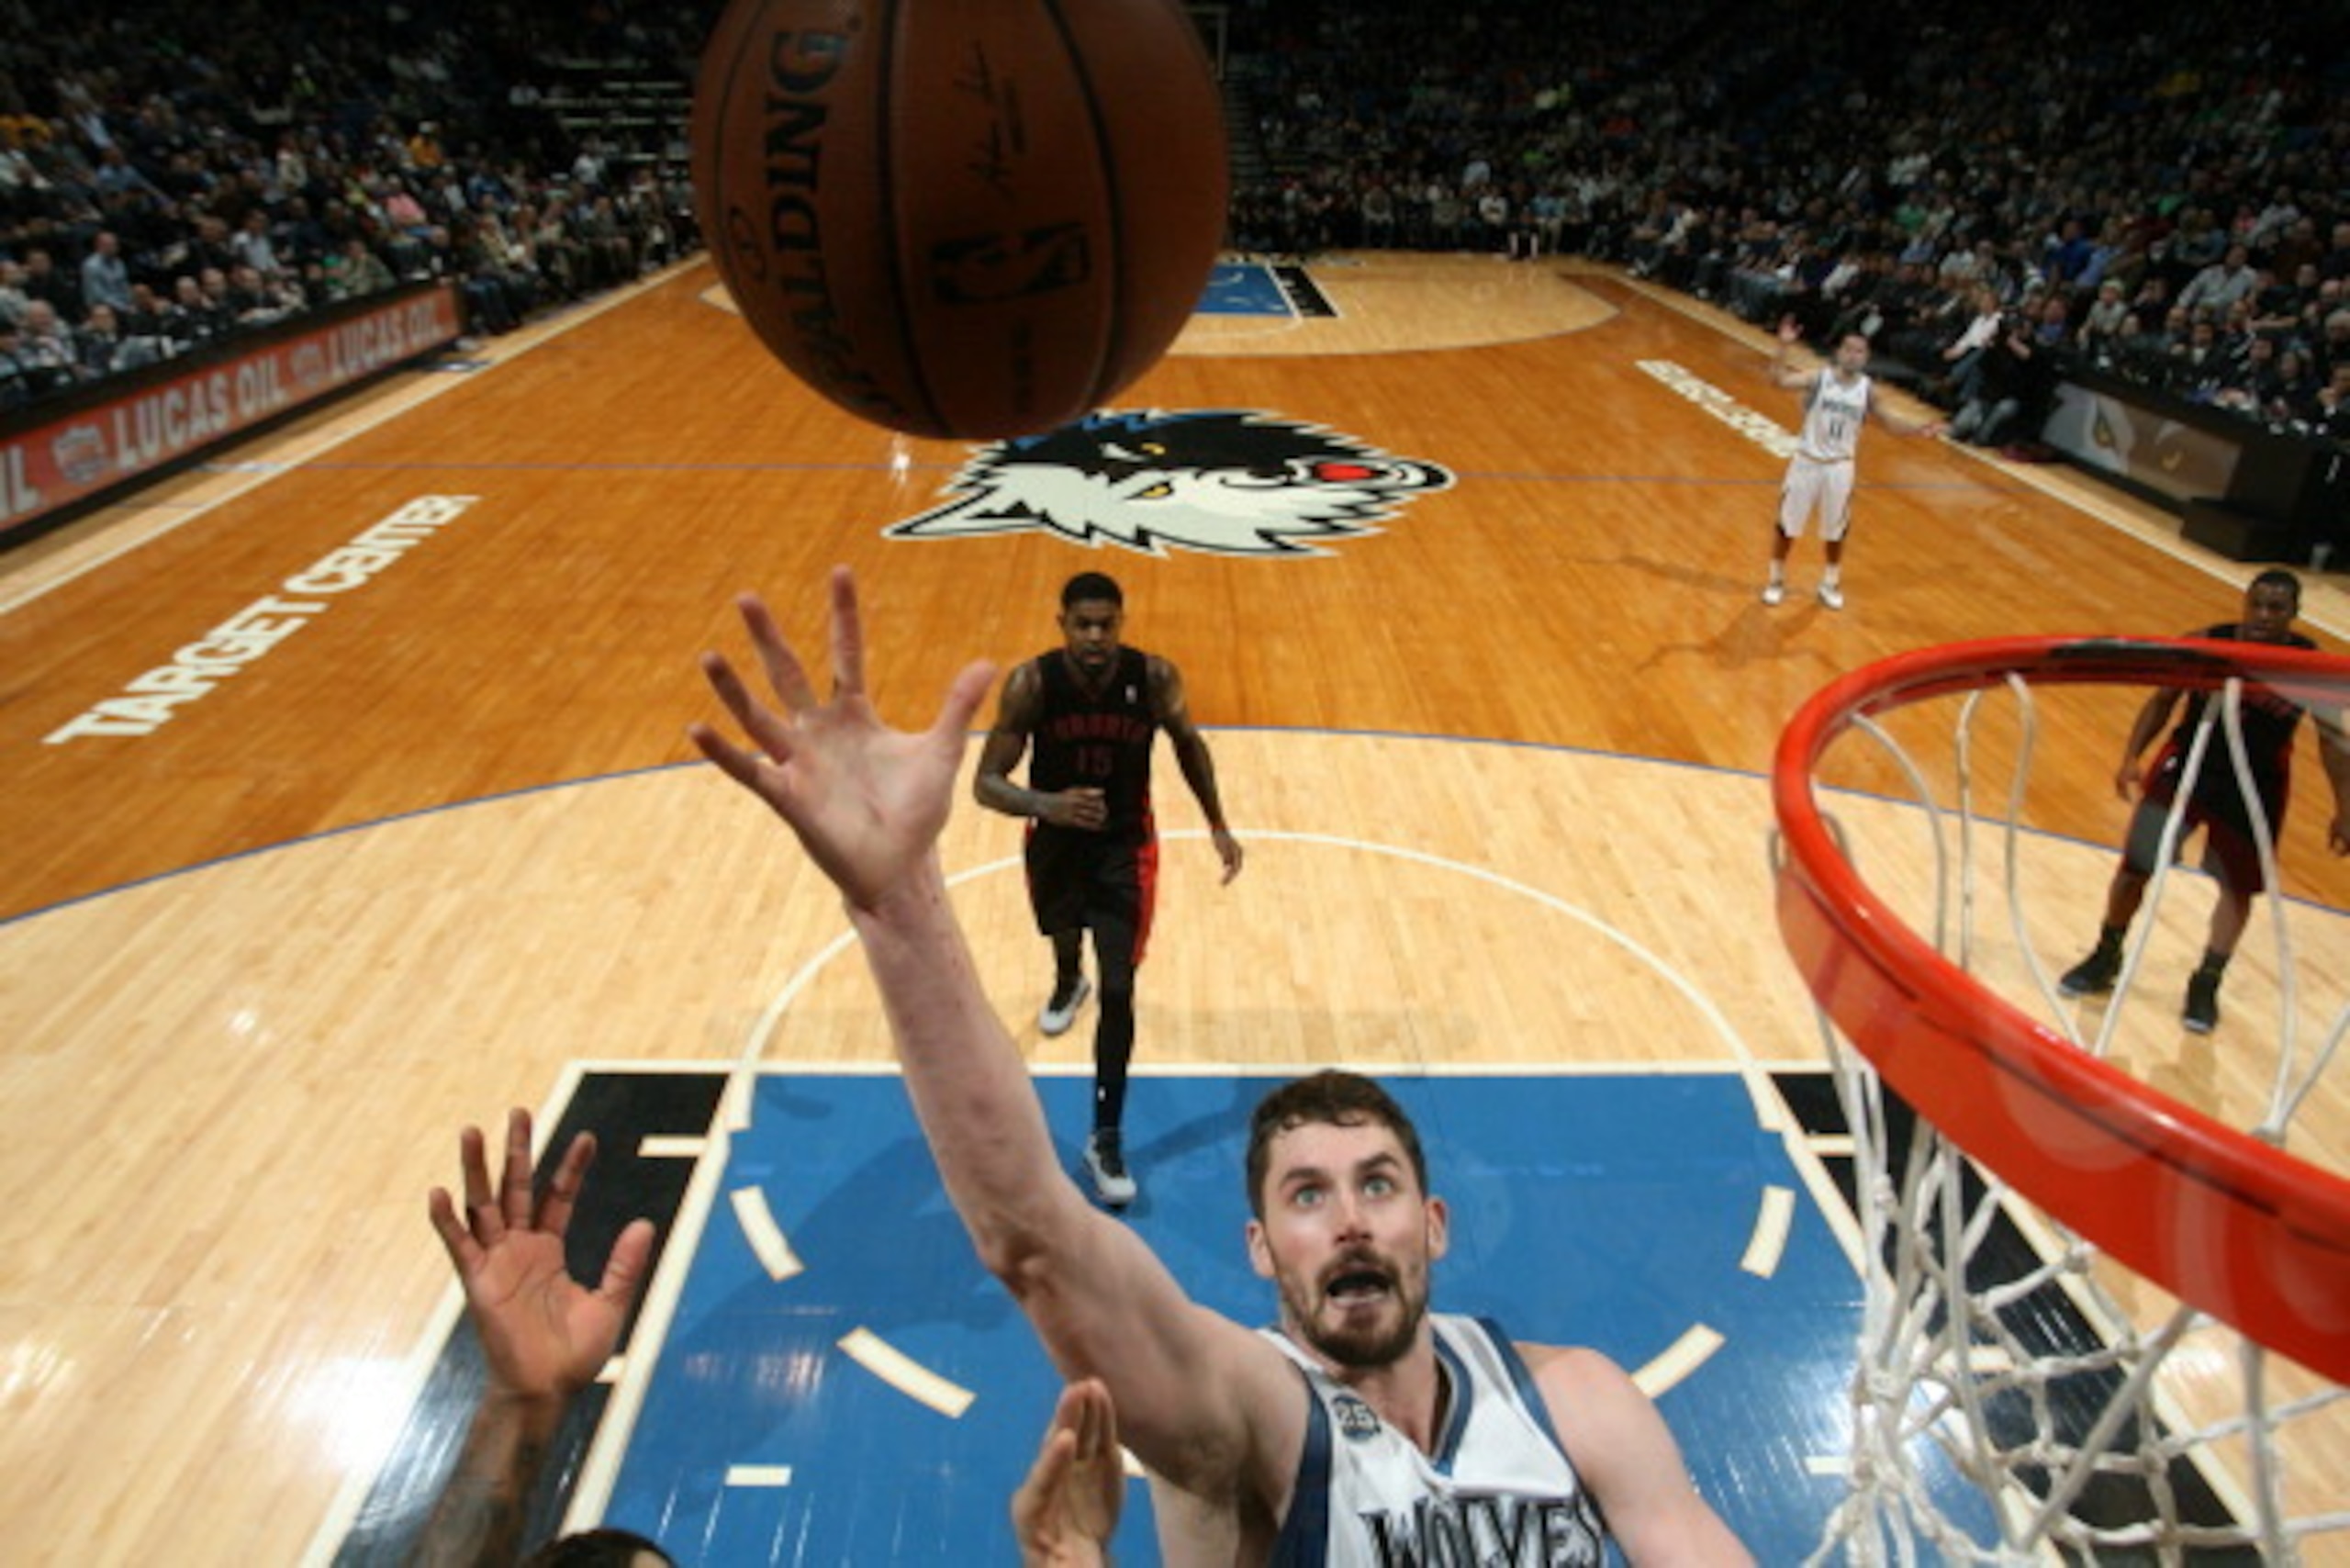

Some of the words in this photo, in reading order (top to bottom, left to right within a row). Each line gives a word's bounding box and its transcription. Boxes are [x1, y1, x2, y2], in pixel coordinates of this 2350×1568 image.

[329, 308, 404, 383] LUCAS
[408, 297, 442, 348] OIL
[112, 368, 230, 469] LUCAS
[238, 355, 291, 415] OIL
[42, 595, 329, 745] TARGET
[283, 494, 482, 594] CENTER
